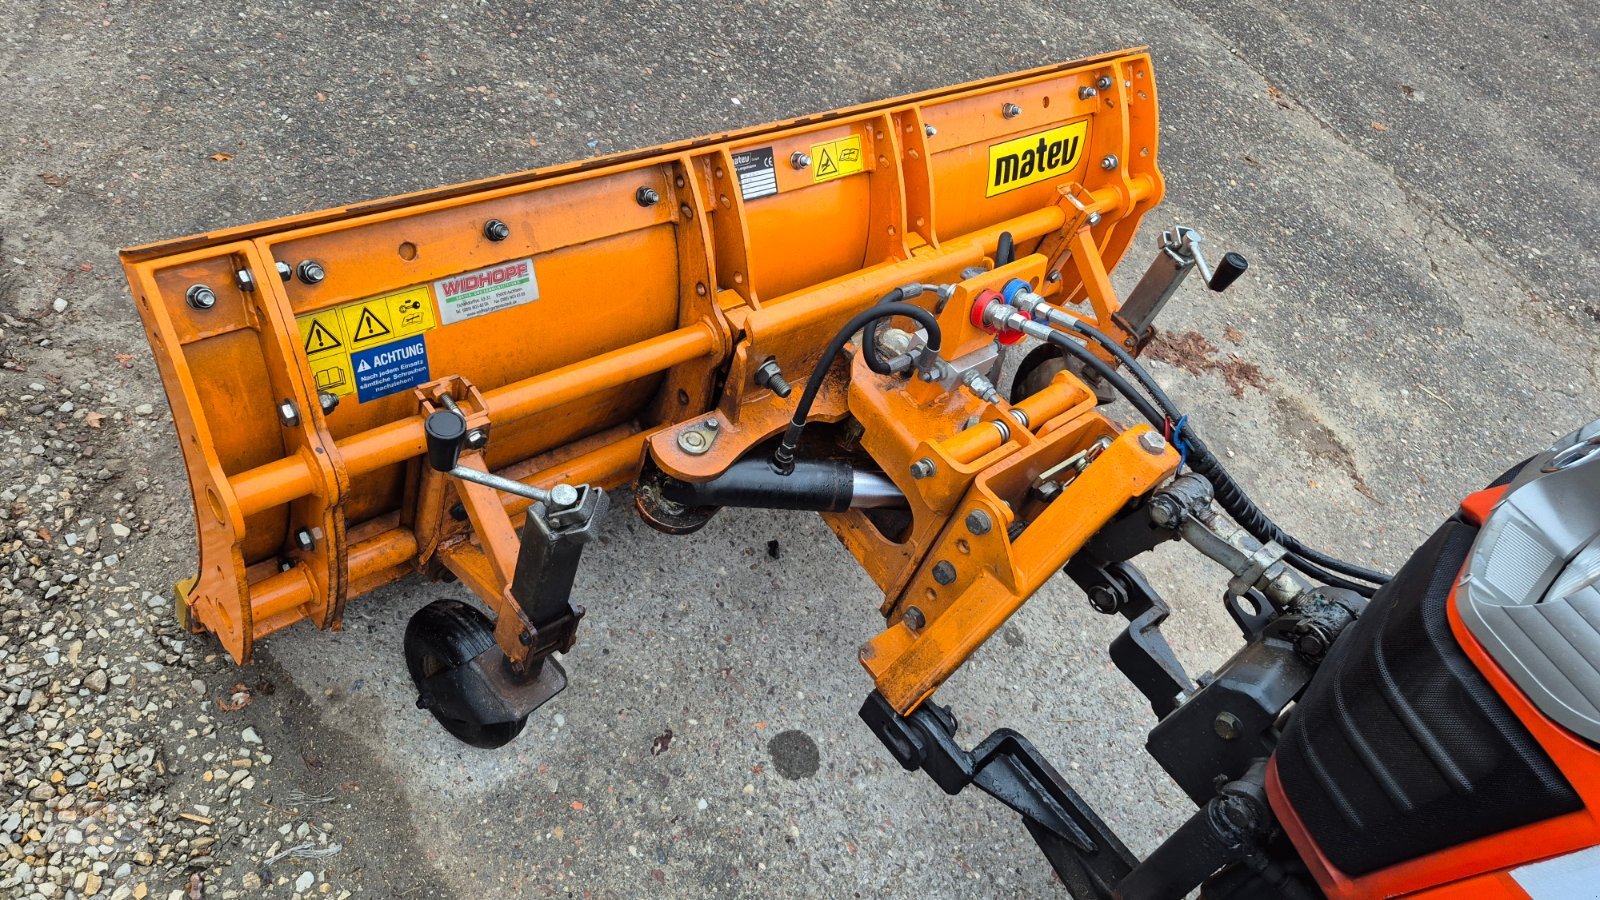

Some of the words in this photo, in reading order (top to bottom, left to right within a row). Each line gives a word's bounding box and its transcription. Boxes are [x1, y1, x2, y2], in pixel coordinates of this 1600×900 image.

[994, 135, 1079, 187] matev
[442, 262, 528, 297] WIDHOPF
[373, 342, 424, 368] ACHTUNG
[359, 377, 391, 390] sämtliche
[393, 366, 427, 380] Schrauben
[360, 372, 379, 382] Nach
[379, 367, 400, 378] jedem
[400, 359, 424, 370] Einsatz
[375, 376, 414, 392] nachziehen!
